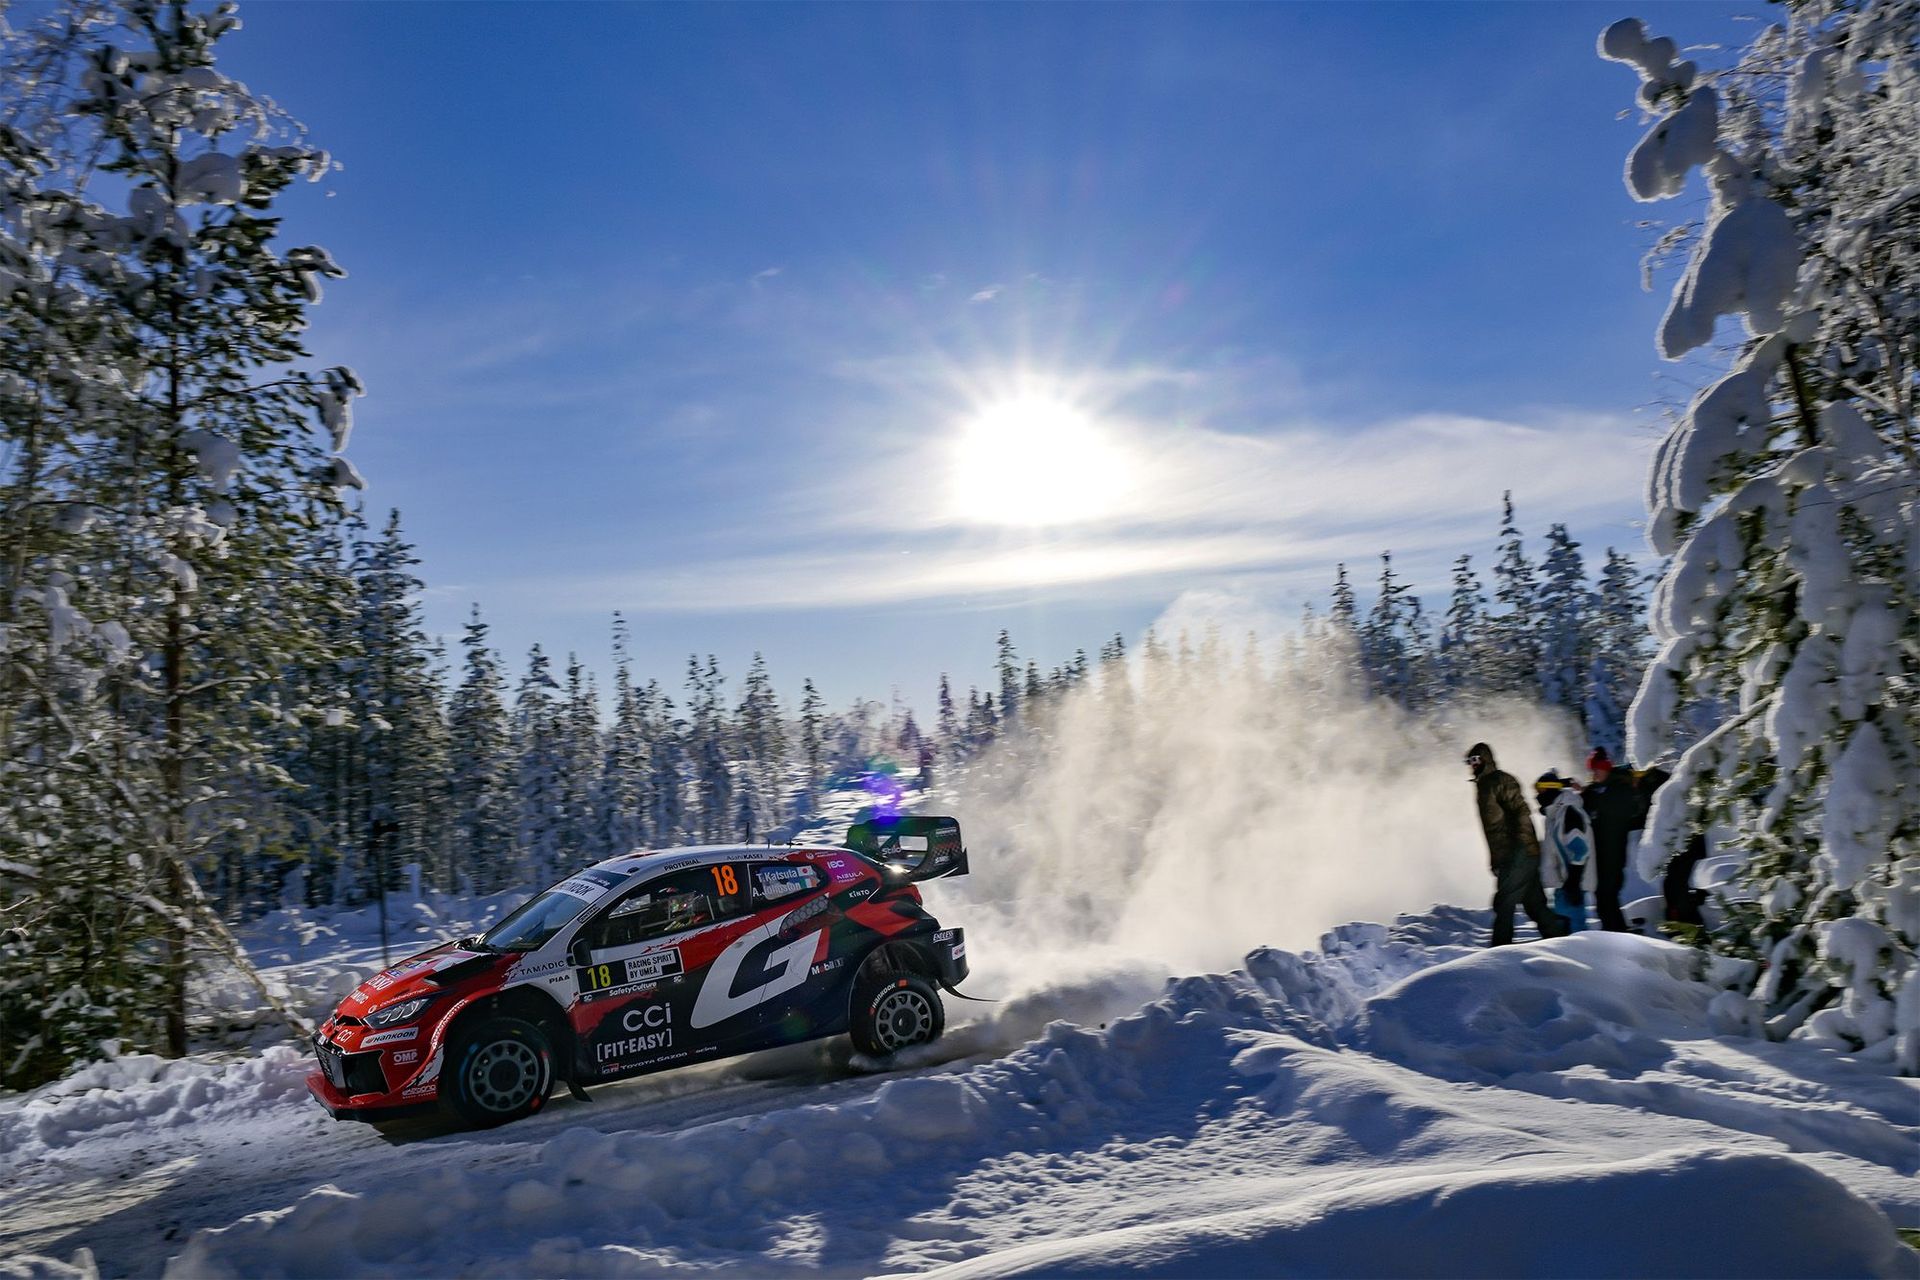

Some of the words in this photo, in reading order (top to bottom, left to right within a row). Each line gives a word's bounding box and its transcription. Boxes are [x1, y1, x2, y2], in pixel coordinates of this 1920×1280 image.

[664, 858, 701, 872] PROTERIAL
[711, 864, 739, 896] 18
[848, 889, 870, 898] KINTO
[520, 960, 564, 976] TAMADIC
[628, 956, 651, 969] RACING
[652, 953, 673, 965] SPIRIT
[549, 975, 570, 984] PIAA
[587, 965, 611, 989] 18
[629, 969, 638, 979] BY
[609, 981, 657, 997] SafetyCulture
[393, 1051, 418, 1063] OMP
